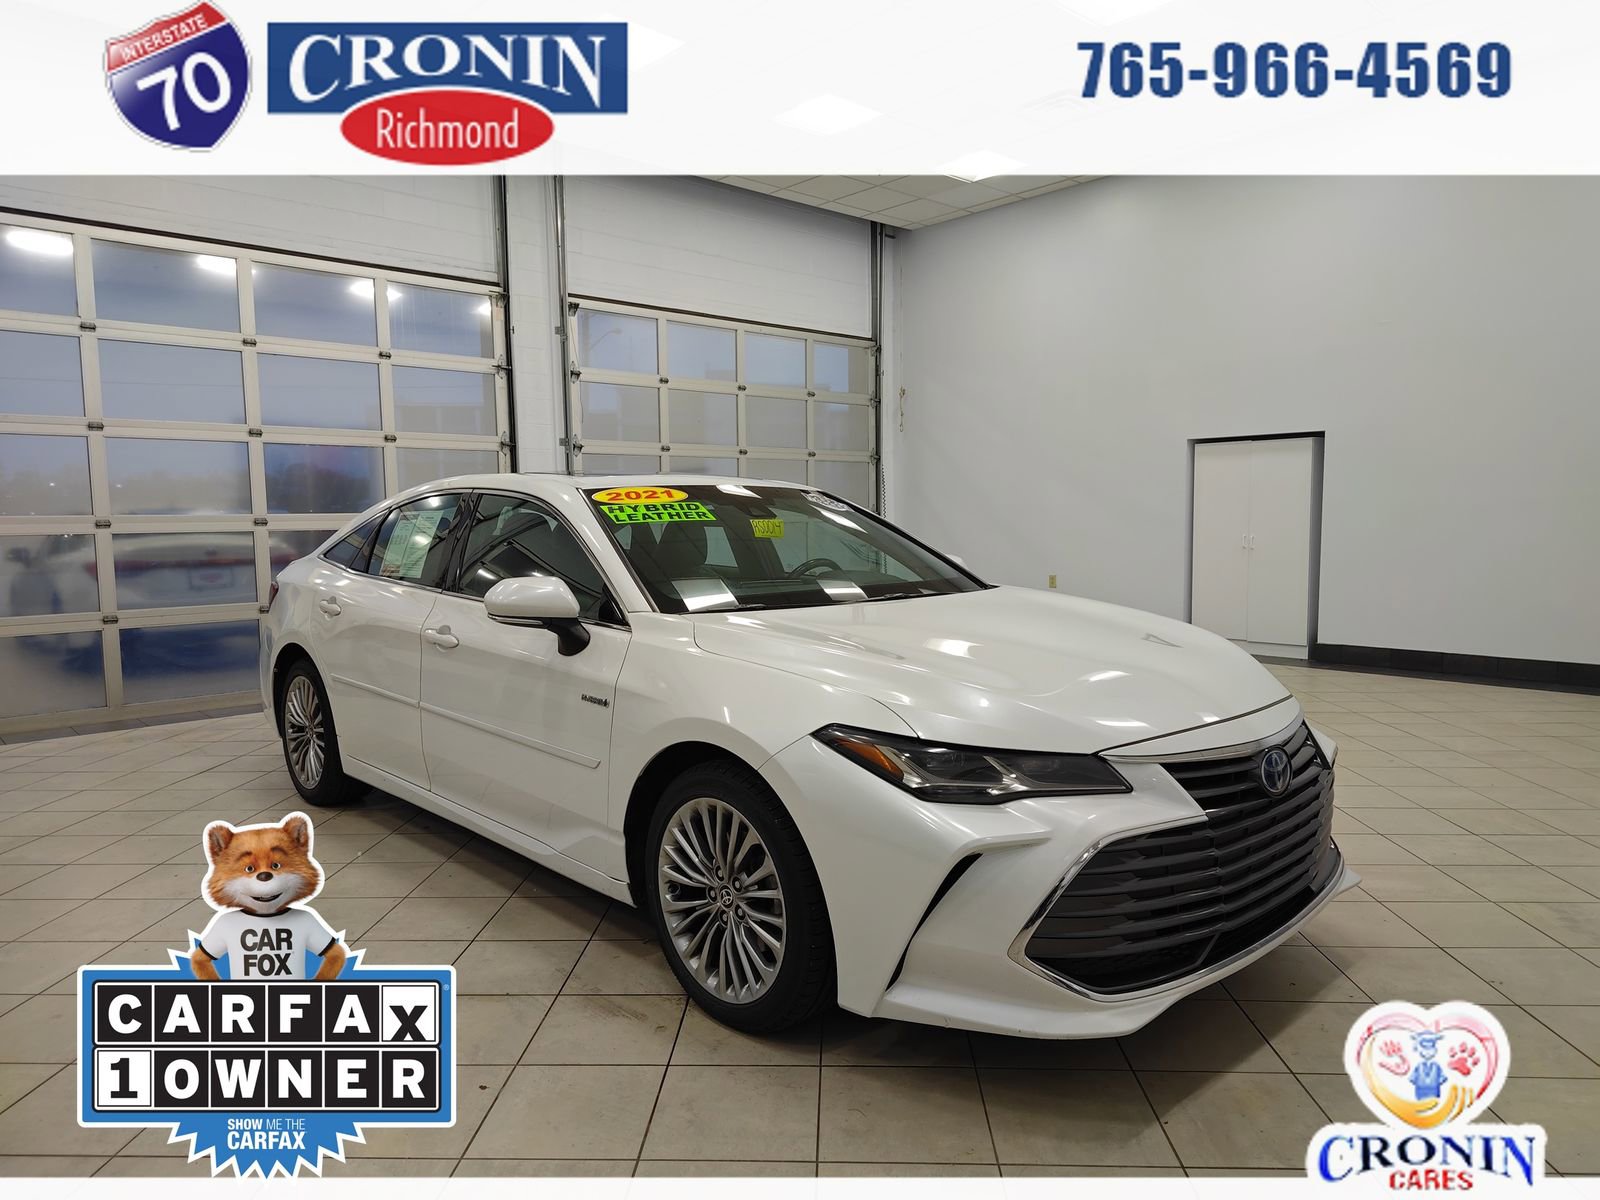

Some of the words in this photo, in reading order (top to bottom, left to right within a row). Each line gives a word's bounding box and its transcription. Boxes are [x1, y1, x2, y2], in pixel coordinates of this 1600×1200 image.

[606, 489, 674, 501] 2021
[607, 503, 700, 513] HYBRID
[613, 511, 710, 522] LEATHER
